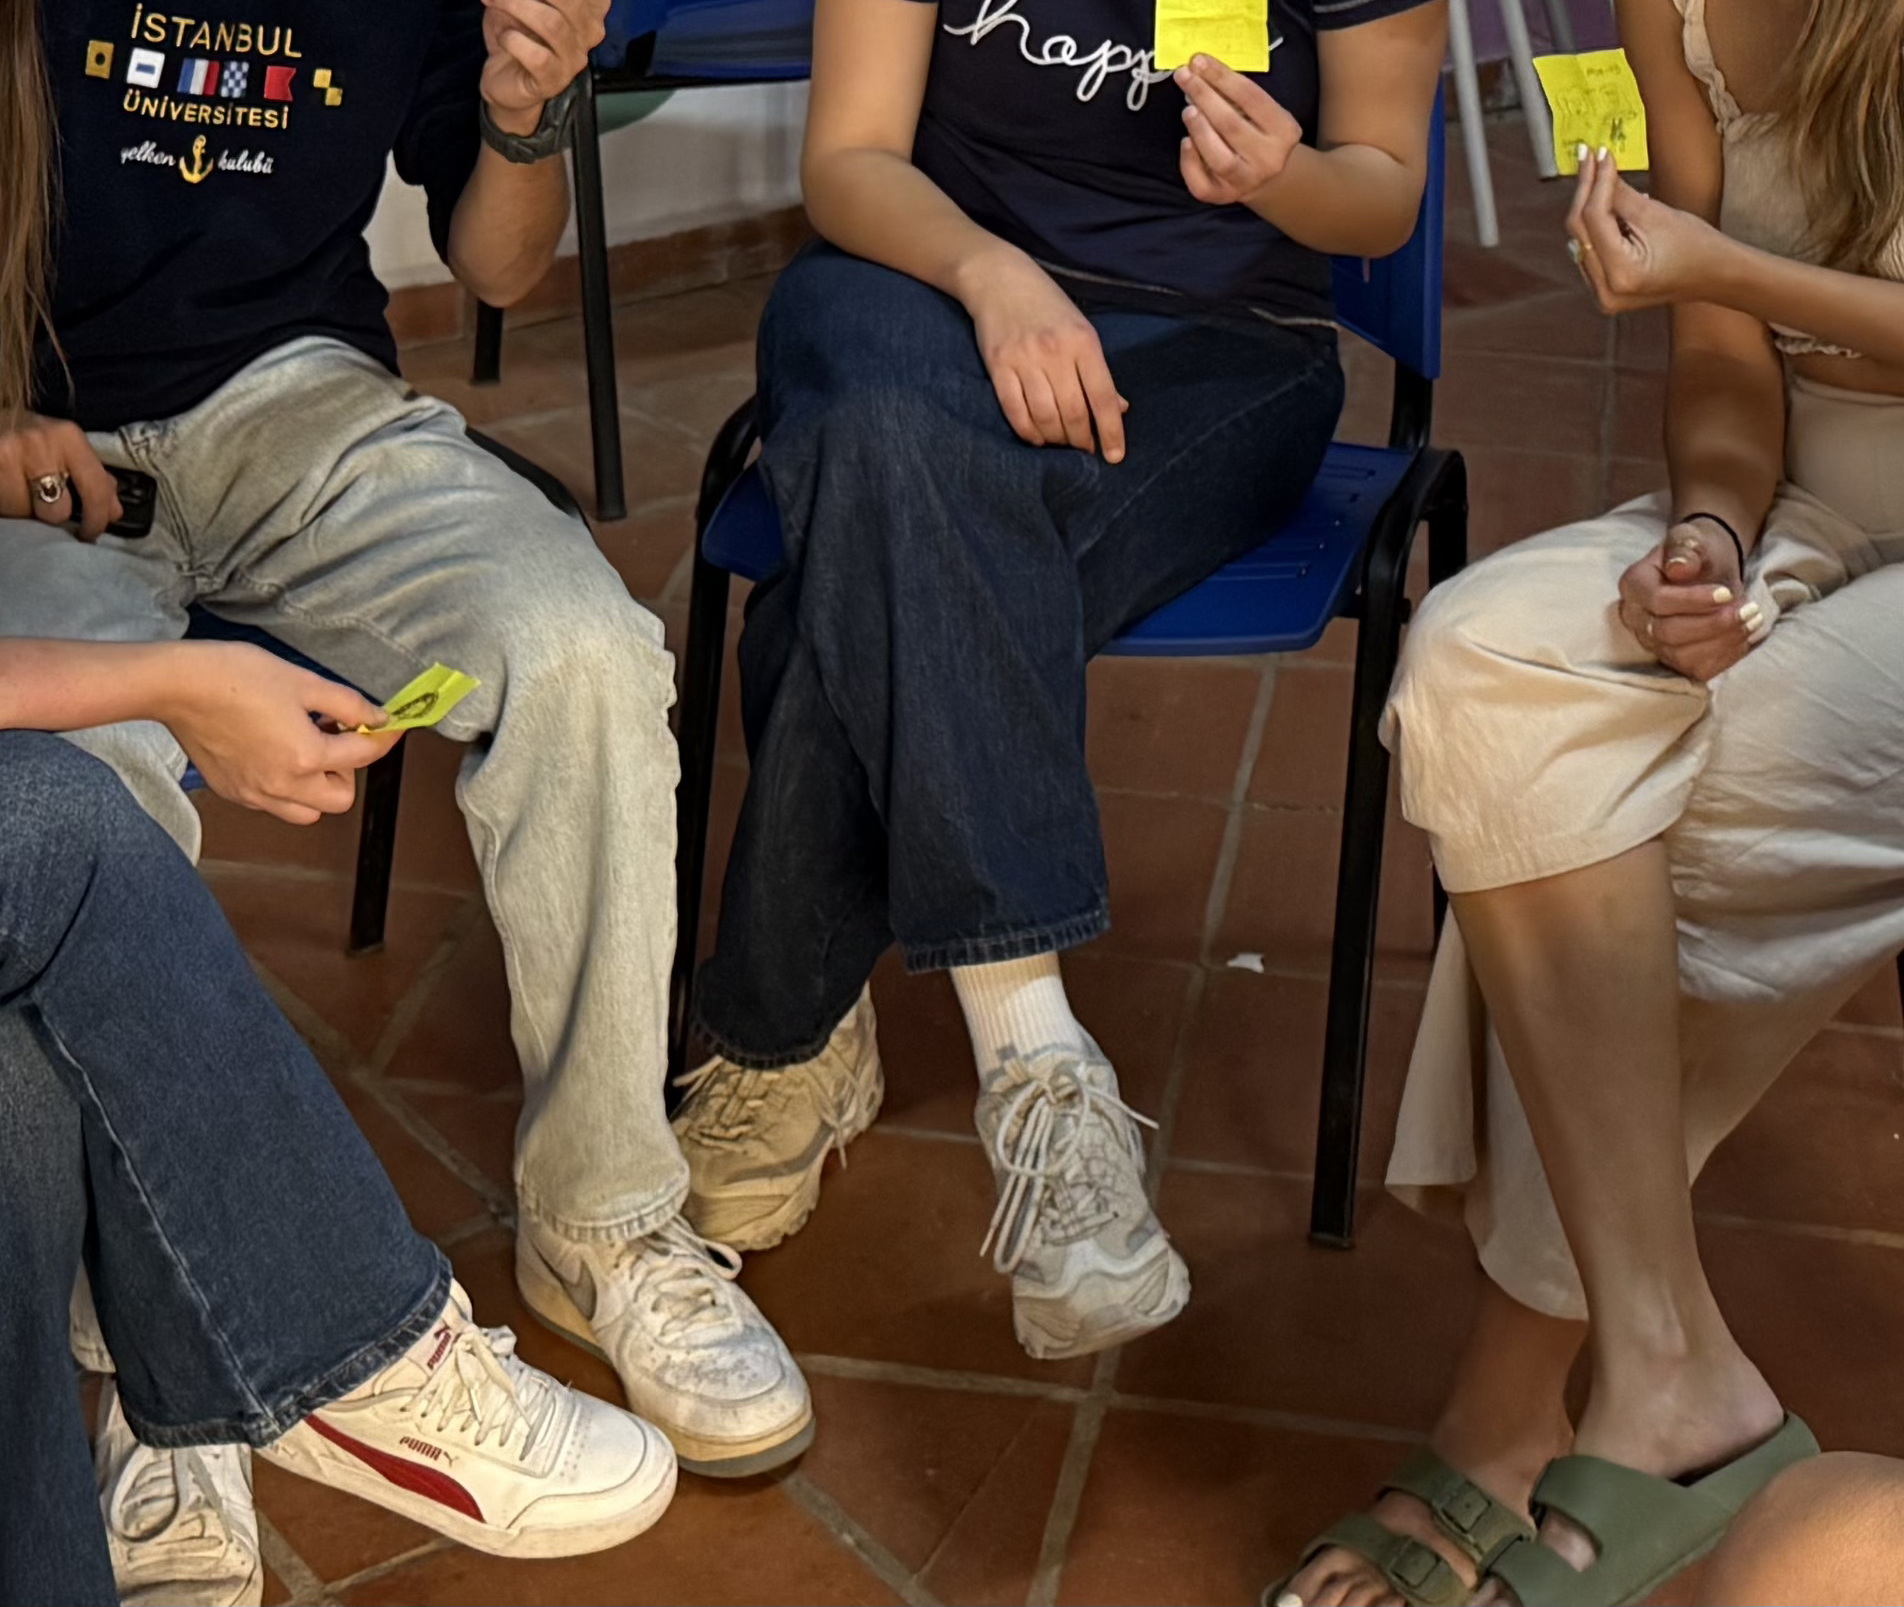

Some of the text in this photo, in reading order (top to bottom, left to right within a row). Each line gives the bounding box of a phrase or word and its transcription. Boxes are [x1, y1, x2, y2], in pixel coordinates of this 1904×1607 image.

[130, 2, 302, 58] İSTANBUL
[123, 88, 290, 130] ÜNİVERSİTESİ
[399, 1435, 442, 1461] PUMA
